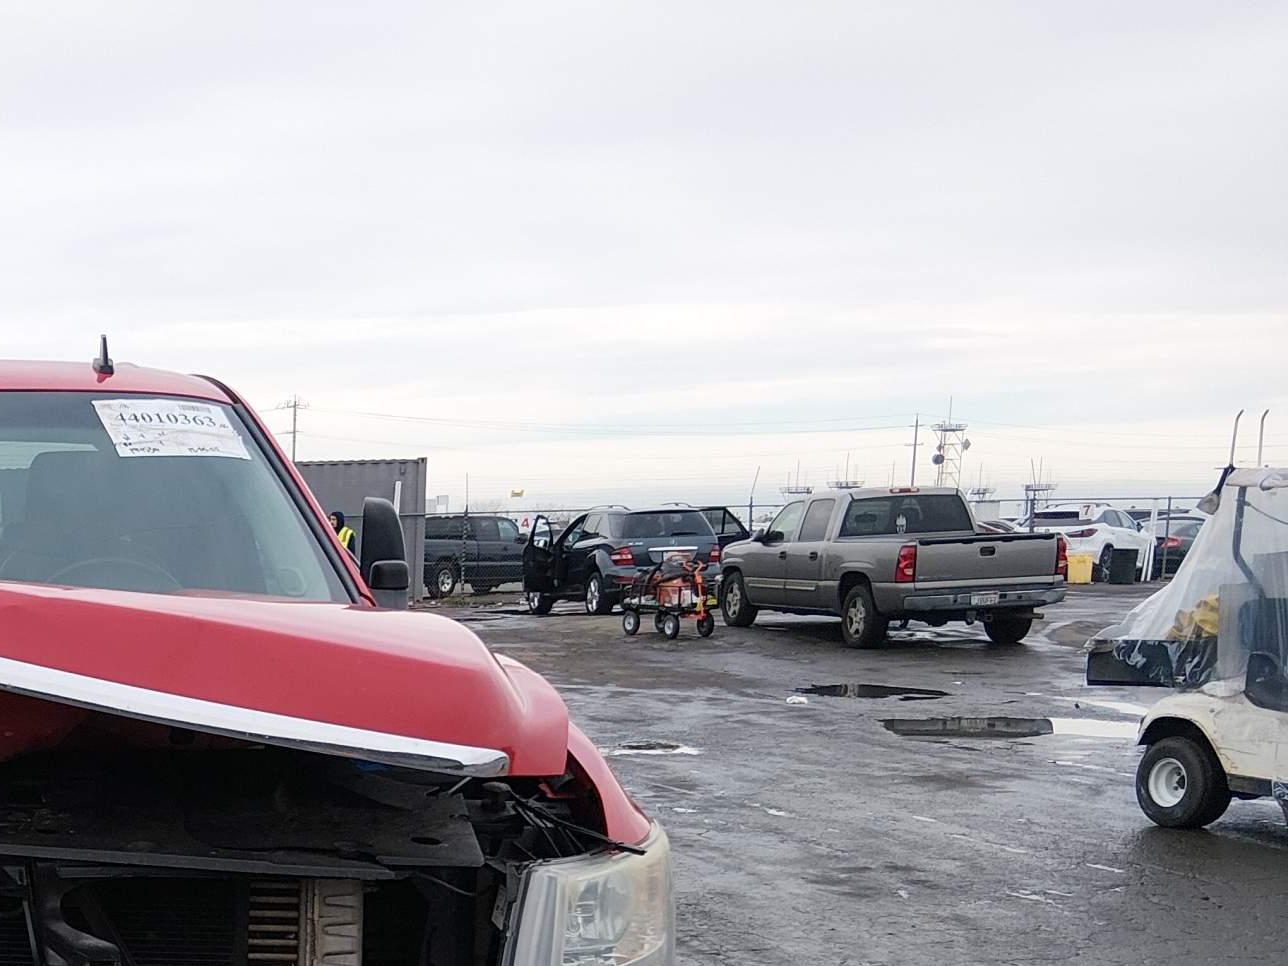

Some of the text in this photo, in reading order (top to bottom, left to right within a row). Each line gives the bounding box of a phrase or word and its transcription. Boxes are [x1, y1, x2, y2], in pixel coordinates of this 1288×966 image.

[115, 412, 216, 428] 44010363
[1082, 504, 1091, 516] 7
[520, 517, 530, 529] 4
